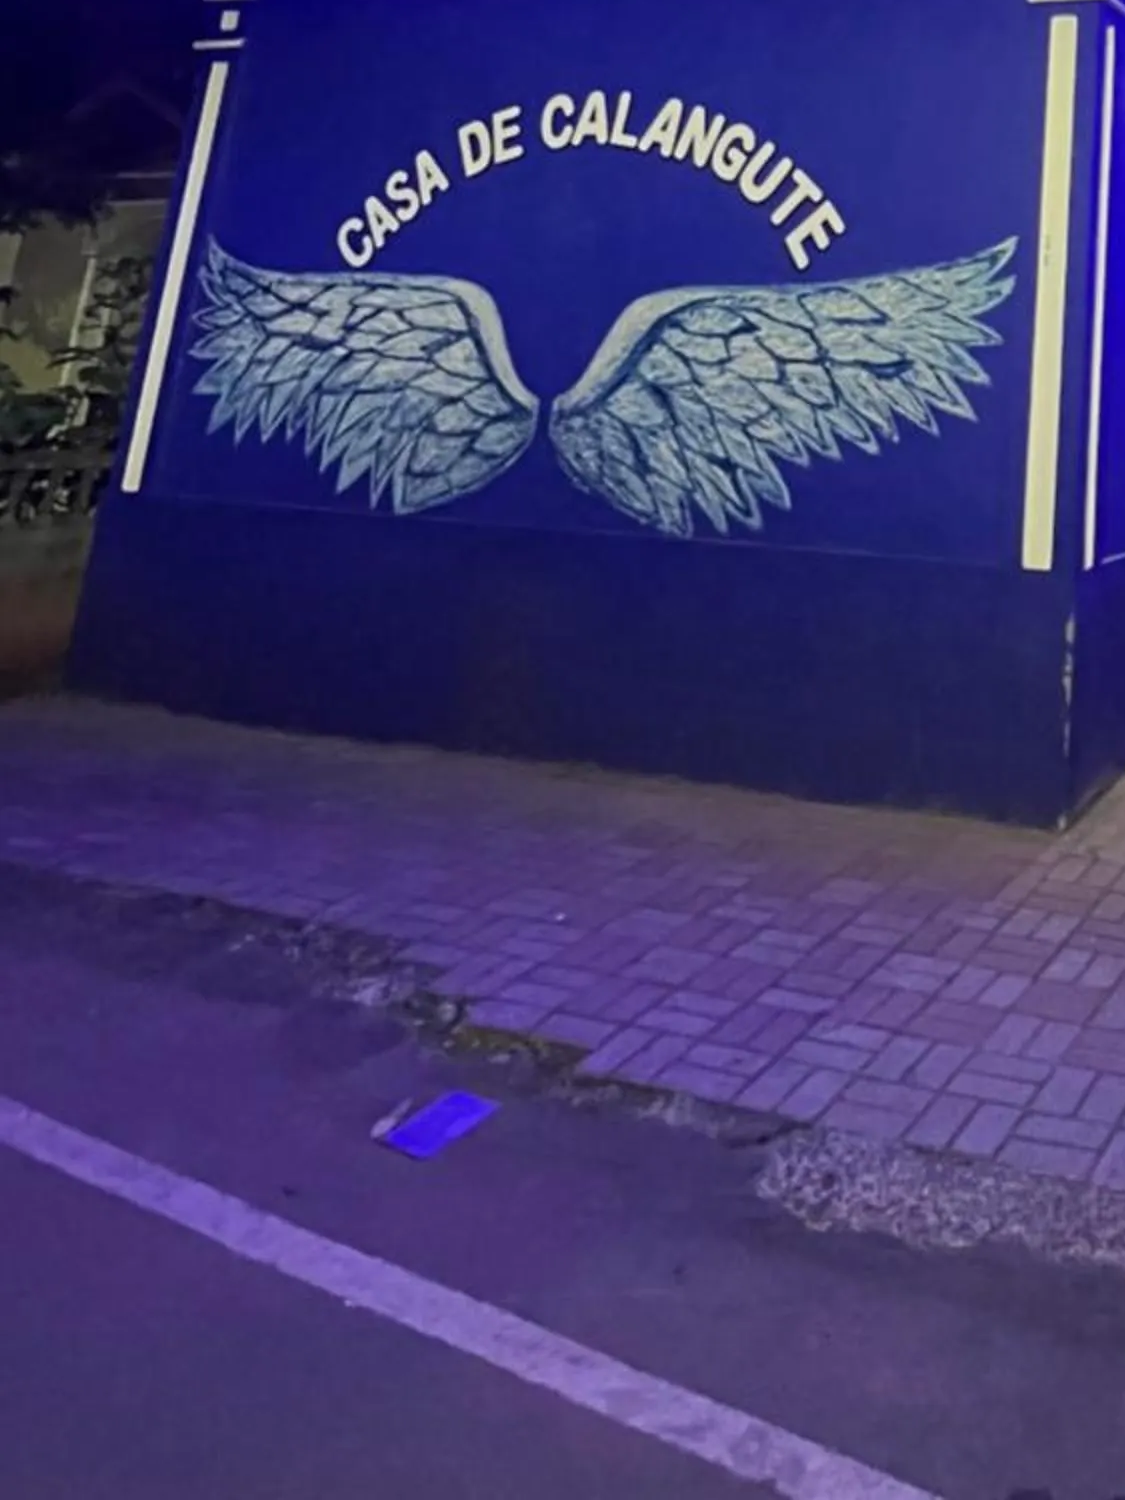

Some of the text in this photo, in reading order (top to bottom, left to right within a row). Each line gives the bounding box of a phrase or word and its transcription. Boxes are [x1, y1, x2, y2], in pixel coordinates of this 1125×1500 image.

[336, 90, 846, 270] CASA DE CALANGUTE
